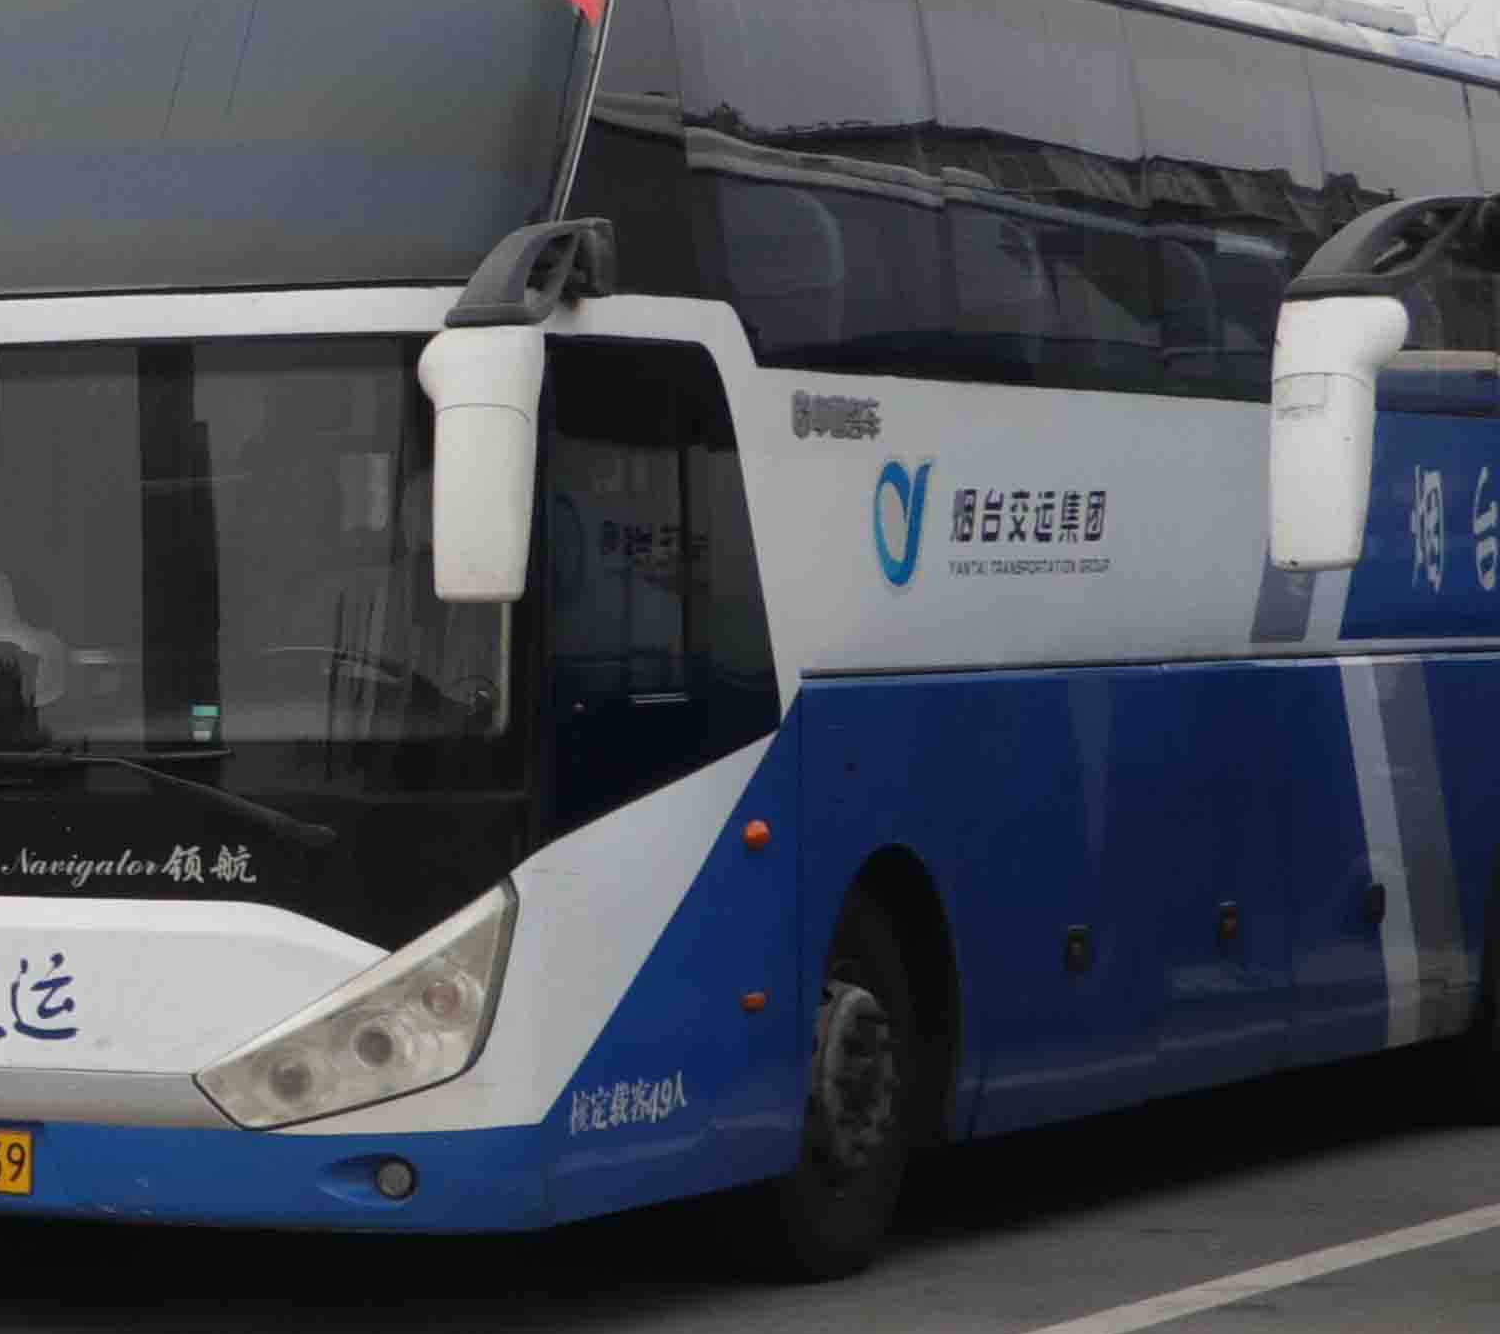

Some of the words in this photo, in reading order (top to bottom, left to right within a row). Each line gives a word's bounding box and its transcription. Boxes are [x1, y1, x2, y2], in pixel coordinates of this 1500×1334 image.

[950, 488, 1107, 544] 烟台交运集团
[1, 846, 160, 889] Navigator
[161, 842, 258, 884] 领航
